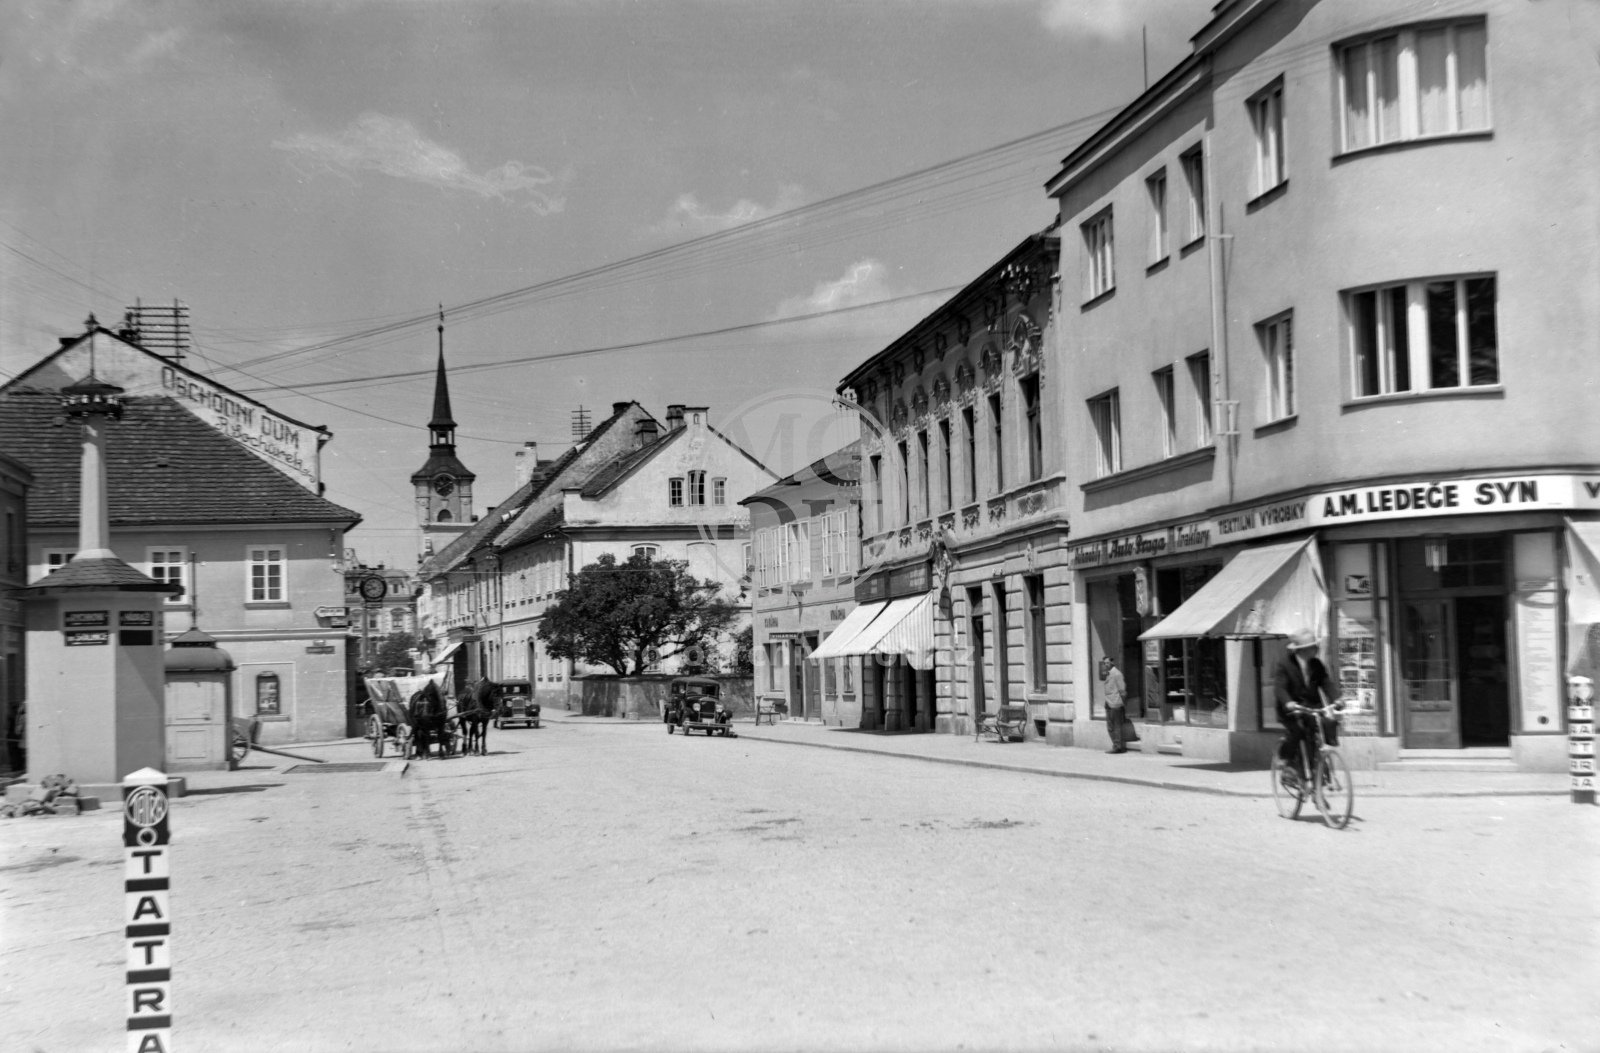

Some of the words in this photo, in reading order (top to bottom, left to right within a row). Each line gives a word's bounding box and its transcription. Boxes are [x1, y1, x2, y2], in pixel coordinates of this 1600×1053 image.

[1366, 481, 1460, 513] LEDEČE
[1474, 480, 1540, 505] SYN
[1218, 508, 1256, 535] TEXTILNÍ
[131, 850, 166, 1053] TATRA
